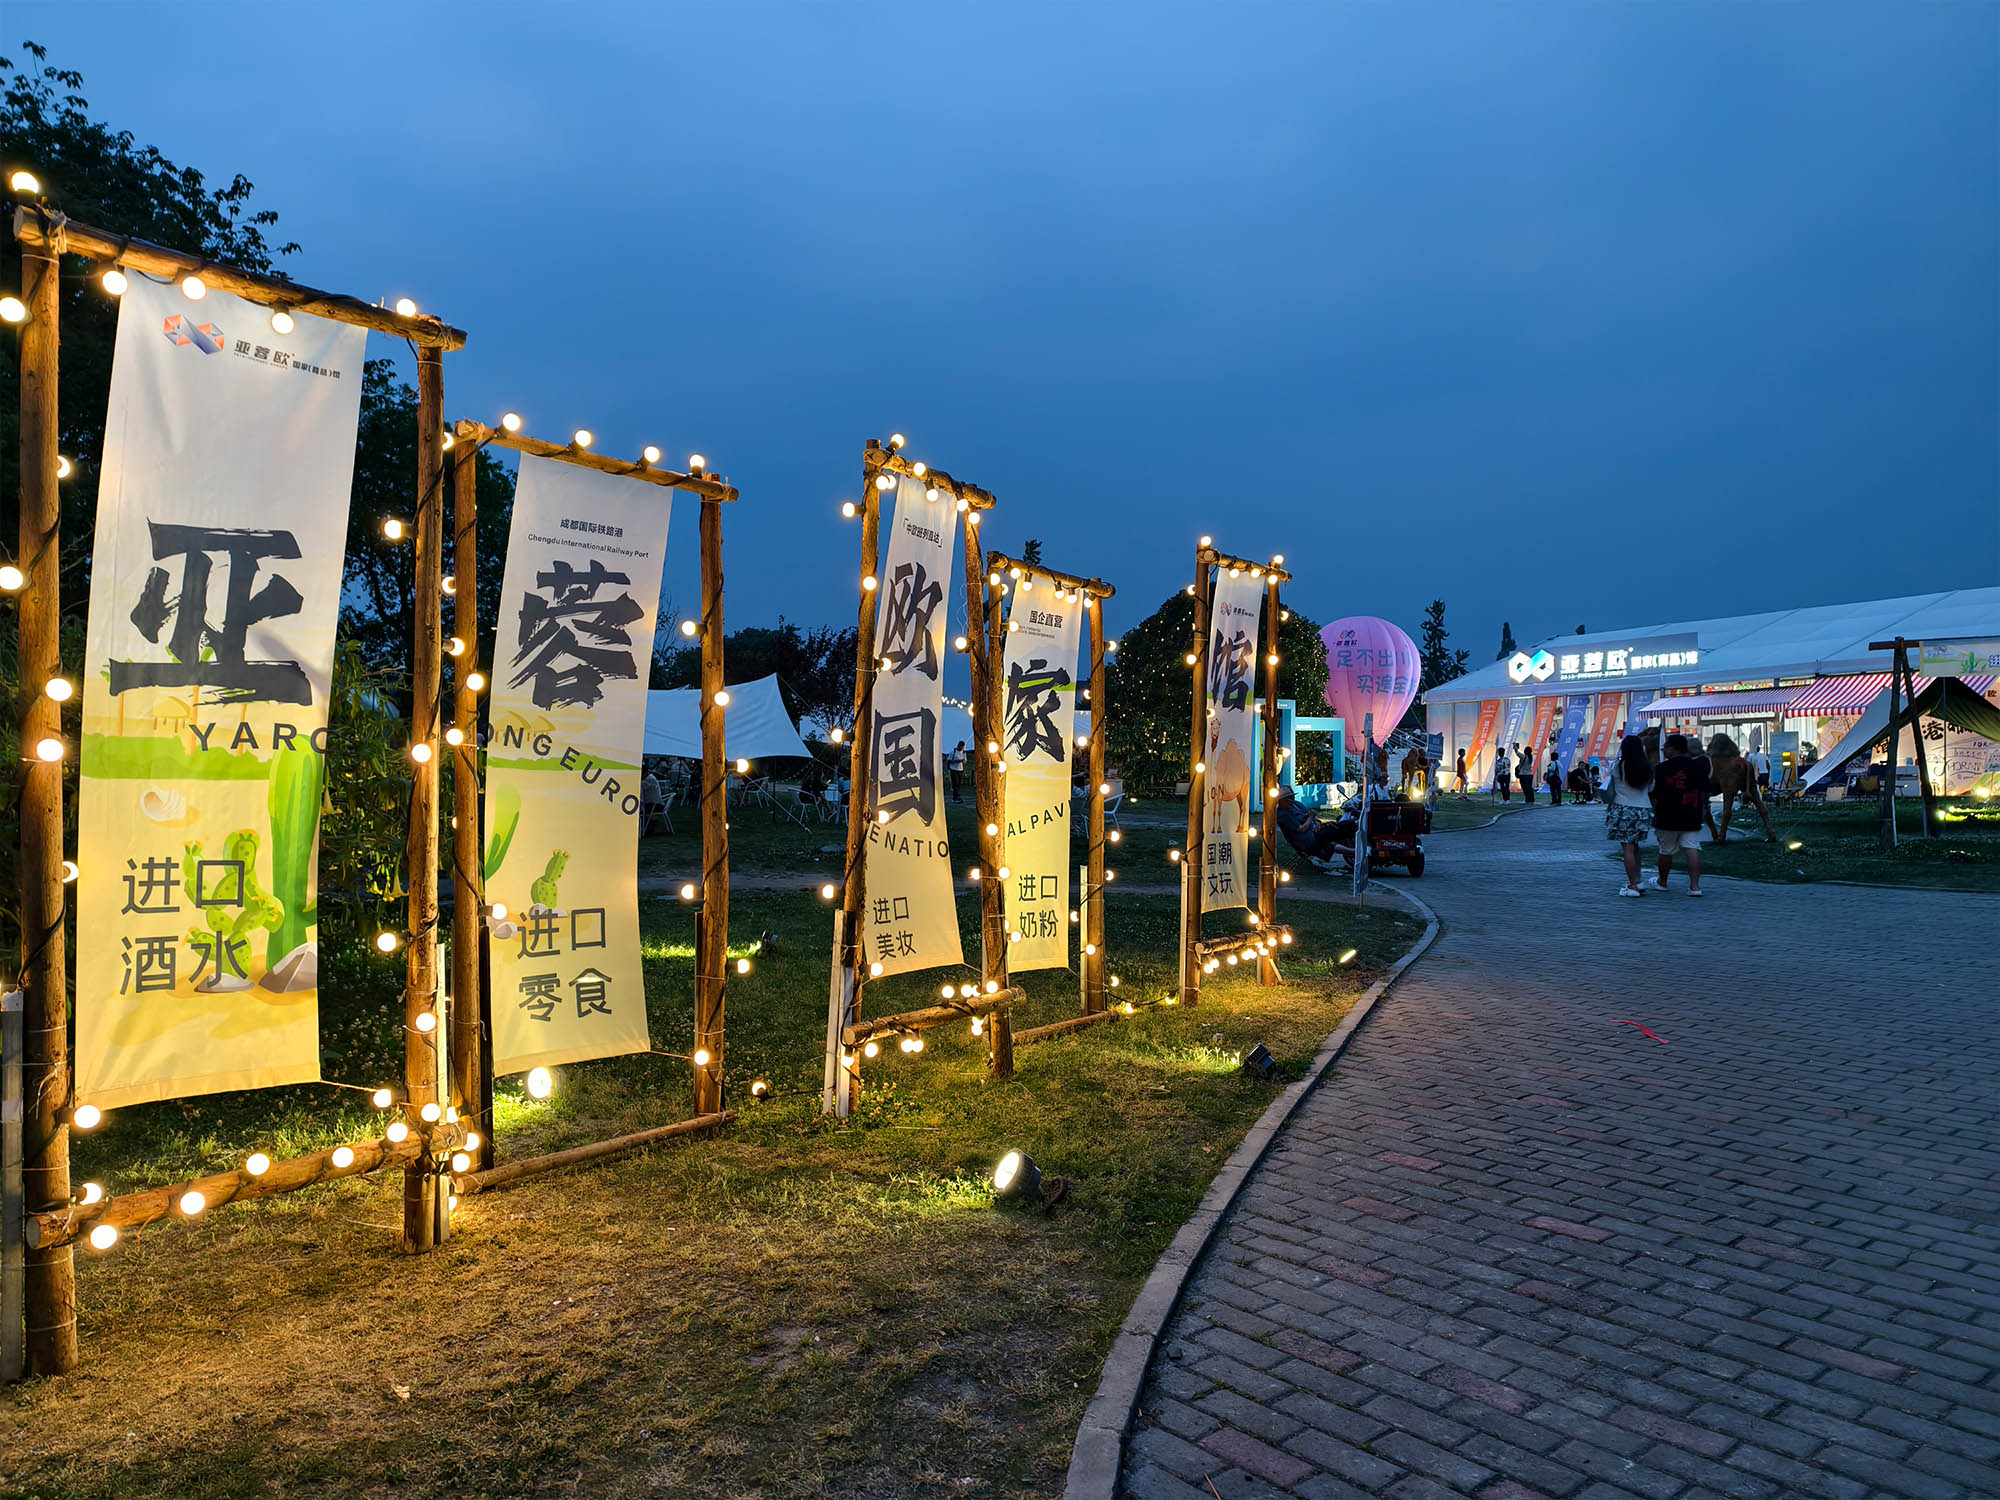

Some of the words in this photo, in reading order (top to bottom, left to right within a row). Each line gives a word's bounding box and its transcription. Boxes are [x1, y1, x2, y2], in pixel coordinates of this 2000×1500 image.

[560, 518, 623, 538] 成都国际铁路港
[528, 533, 560, 545] Chengdu
[561, 538, 606, 552] International
[607, 545, 634, 558] Railway
[634, 550, 649, 559] Port
[109, 516, 312, 706] 亚
[1029, 610, 1063, 629] 国企直营
[507, 560, 645, 712] 蓉
[1337, 648, 1412, 668] 足不出川
[1004, 658, 1071, 762] 家
[1207, 842, 1232, 865] 国潮
[121, 856, 245, 915] 进口
[1018, 874, 1058, 901] 进口
[1207, 872, 1233, 896] 文玩
[873, 896, 910, 925] 进口
[1019, 910, 1059, 938] 奶粉
[517, 907, 606, 959] 进口
[876, 930, 917, 960] 美妆
[120, 930, 248, 995] 酒水
[518, 968, 612, 1022] 零食
